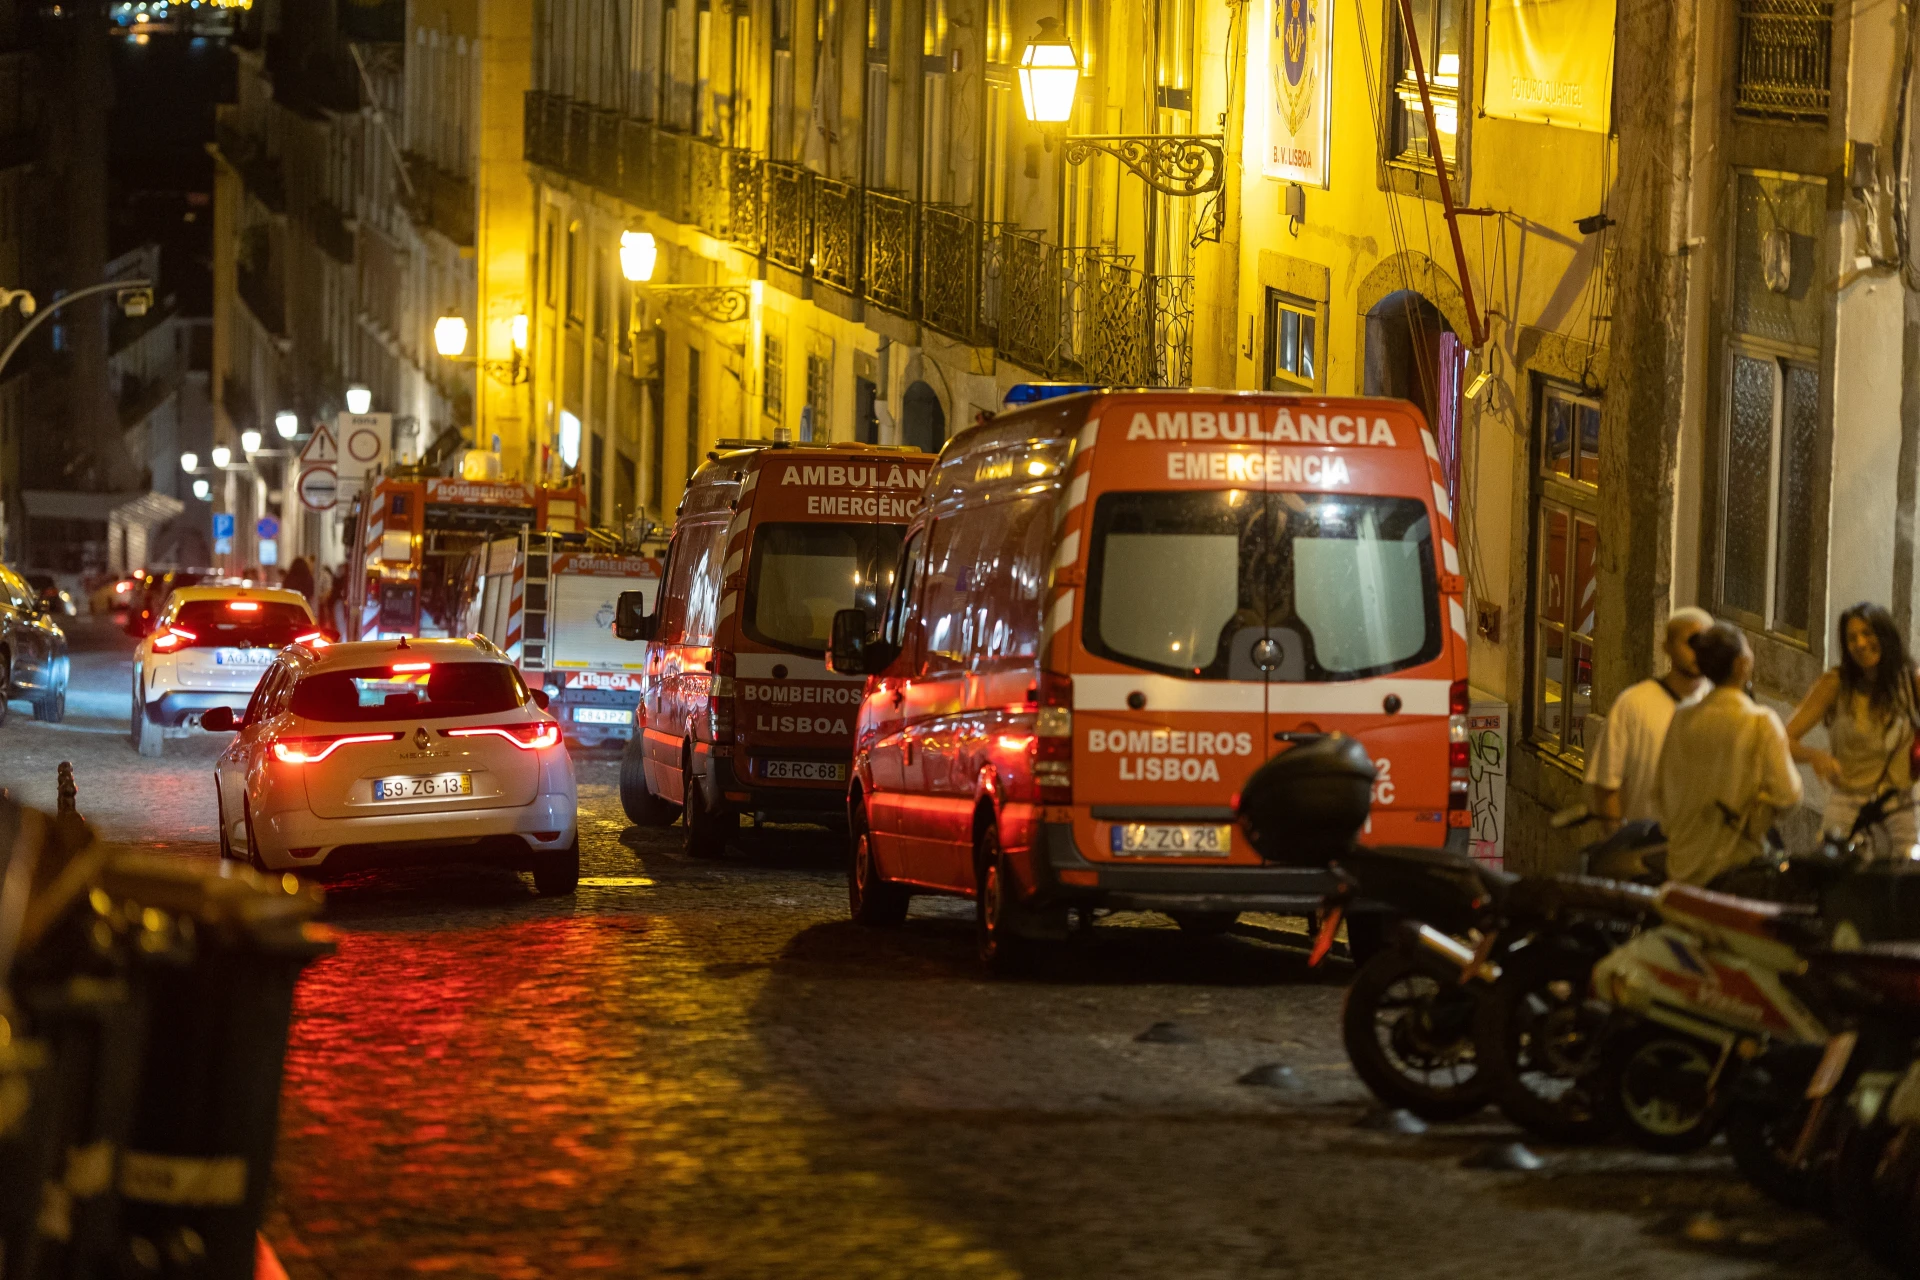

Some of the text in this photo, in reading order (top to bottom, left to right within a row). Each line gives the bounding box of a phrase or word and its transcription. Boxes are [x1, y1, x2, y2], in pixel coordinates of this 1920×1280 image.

[1511, 76, 1582, 108] FUTURO QUARTEL
[1273, 145, 1280, 164] B.
[1288, 147, 1312, 168] LISBOA
[1126, 408, 1397, 447] AMBULÂNCIA
[1167, 448, 1351, 486] EMERGÊNCIA
[437, 484, 524, 499] BOMBEIROS
[568, 558, 650, 572] BOMBEIROS
[579, 671, 630, 688] LISBOA
[744, 684, 862, 705] BOMBEIROS
[756, 715, 849, 735] LISBOA
[1088, 729, 1253, 756] BOMBEIROS
[1119, 757, 1221, 782] LISBOA
